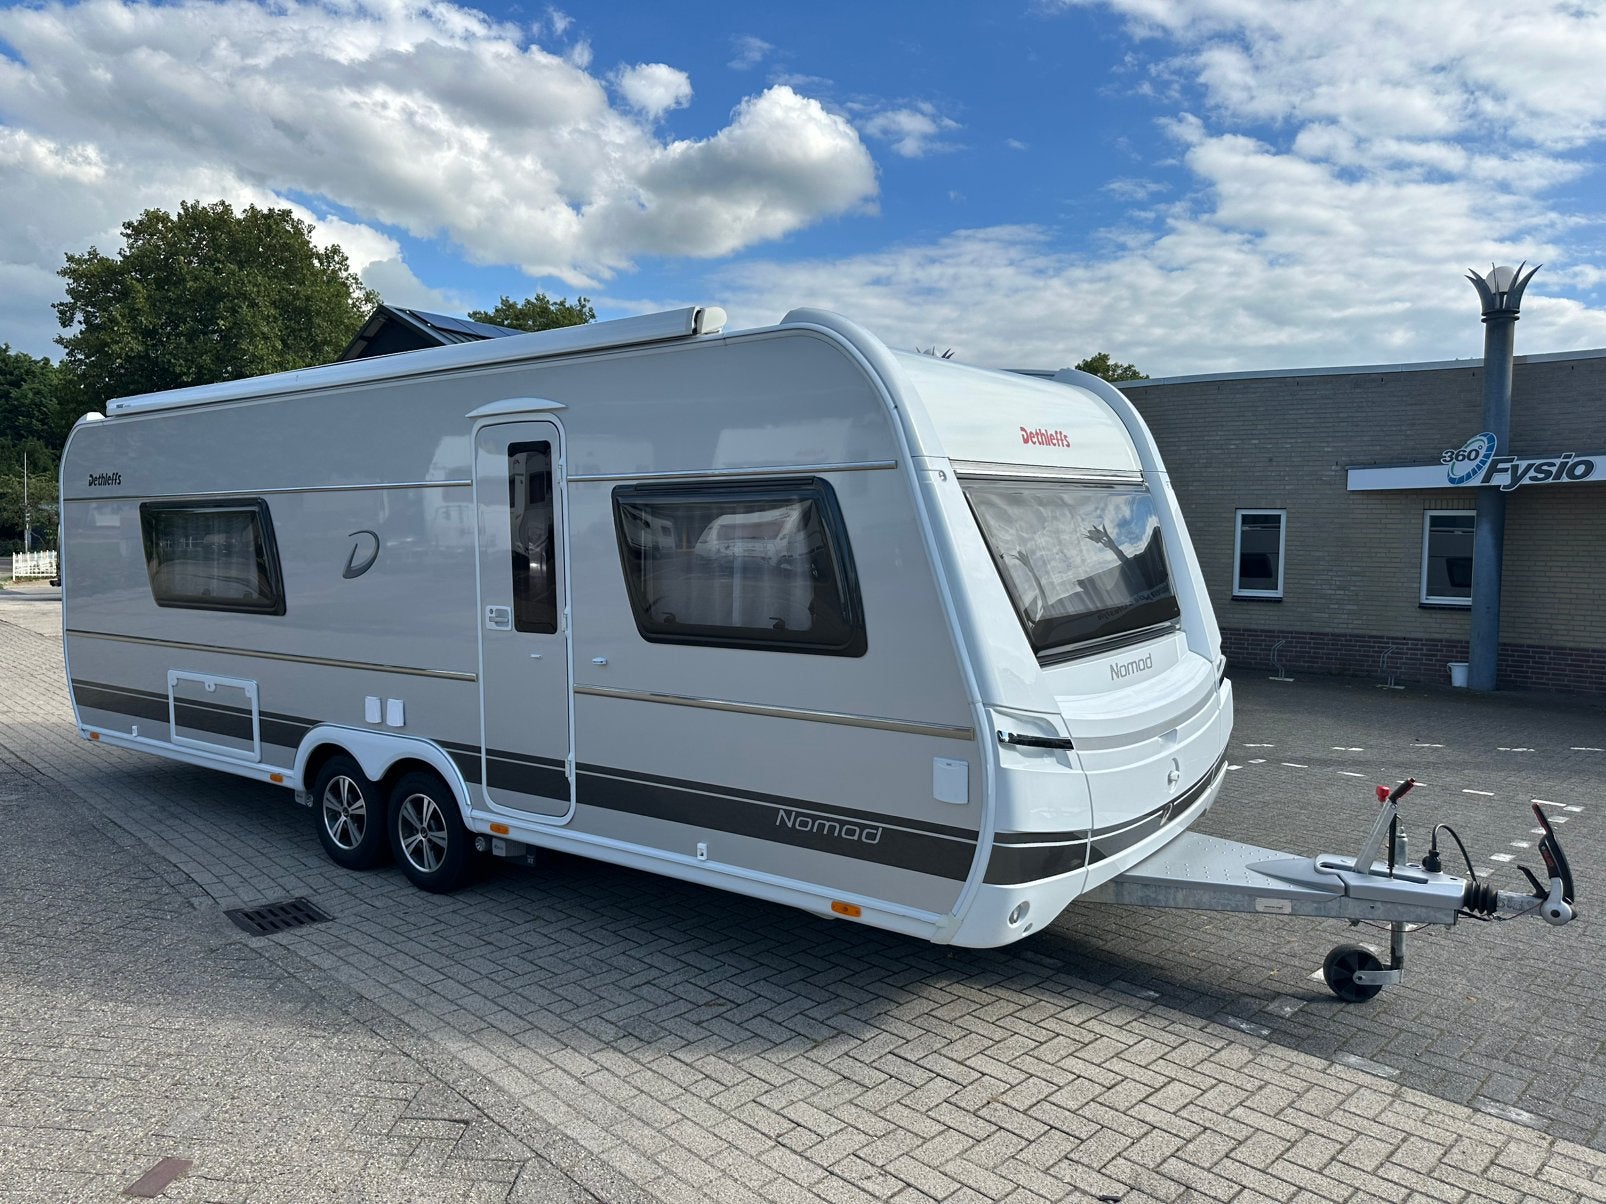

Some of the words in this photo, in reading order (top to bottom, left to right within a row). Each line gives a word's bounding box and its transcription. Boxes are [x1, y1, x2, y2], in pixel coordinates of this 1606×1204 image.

[1019, 426, 1071, 448] Dethleffs
[88, 472, 122, 487] Dethleffs
[1480, 453, 1595, 490] Fysio
[1110, 652, 1153, 681] Nomad
[775, 809, 883, 844] Nomad
